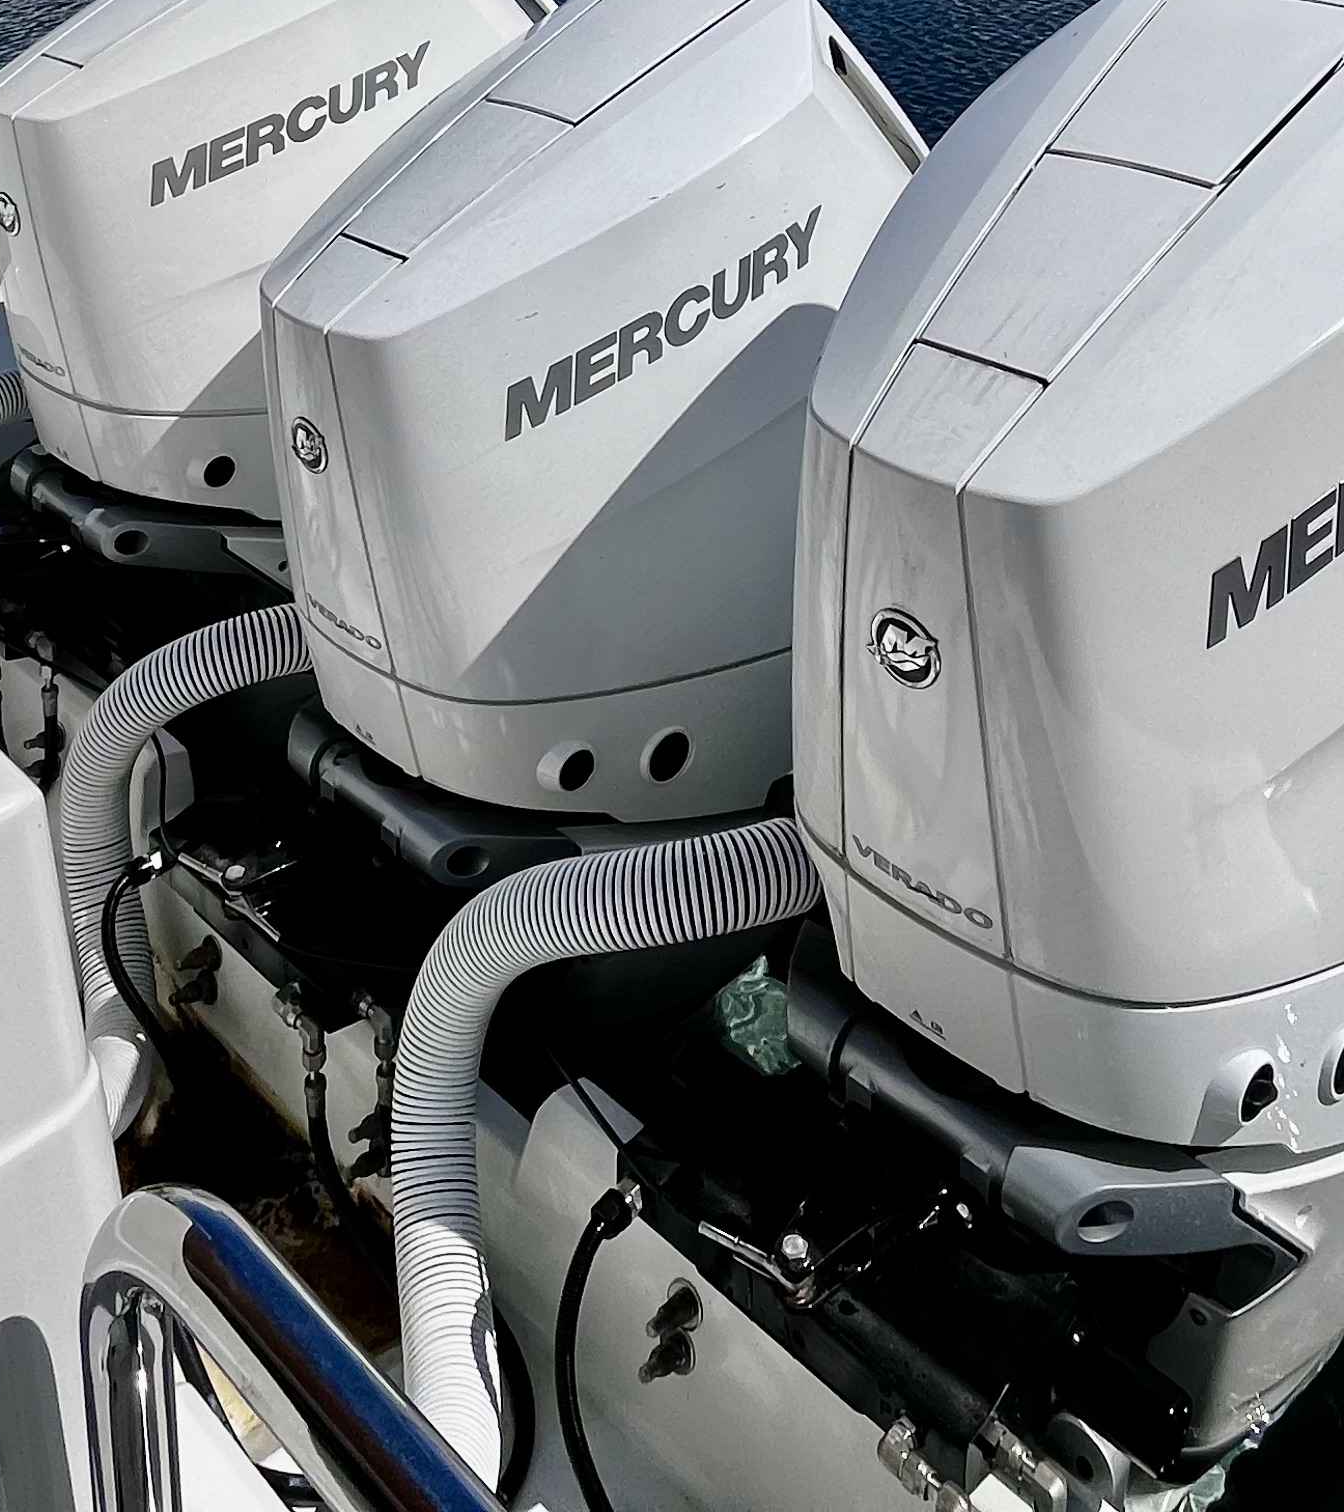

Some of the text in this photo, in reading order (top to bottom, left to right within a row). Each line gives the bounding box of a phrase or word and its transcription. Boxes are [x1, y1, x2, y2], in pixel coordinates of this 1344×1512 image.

[149, 40, 431, 207] MERCURY
[504, 204, 822, 443] MERCURY
[851, 834, 993, 929] VERADO
